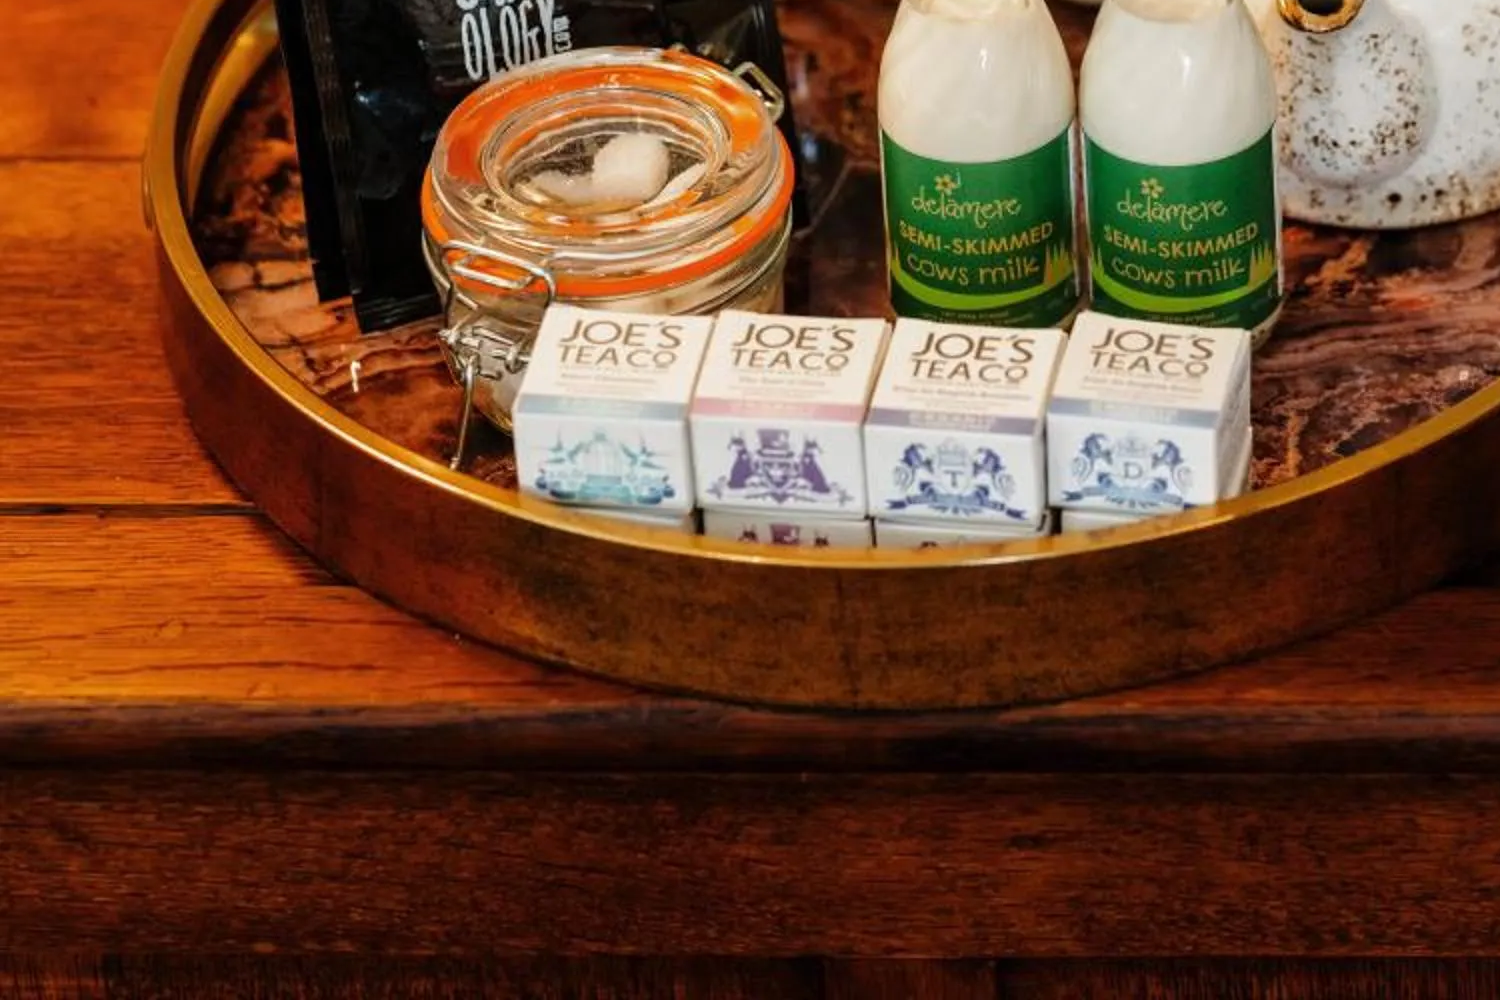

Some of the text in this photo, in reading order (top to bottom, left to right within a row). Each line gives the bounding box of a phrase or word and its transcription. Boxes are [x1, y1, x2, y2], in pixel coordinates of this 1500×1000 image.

[911, 185, 1022, 229] delamere
[1117, 189, 1228, 231] delamere
[899, 219, 1054, 256] SEMI-SKIMMED
[1103, 221, 1259, 260] SEMI-SKIMMED
[979, 256, 1040, 285] milk
[1184, 257, 1245, 287] milk
[559, 319, 684, 349] JOE'S
[733, 323, 857, 352] JOE'S
[911, 332, 1036, 364] JOE'S
[1091, 328, 1216, 360] JOE'S
